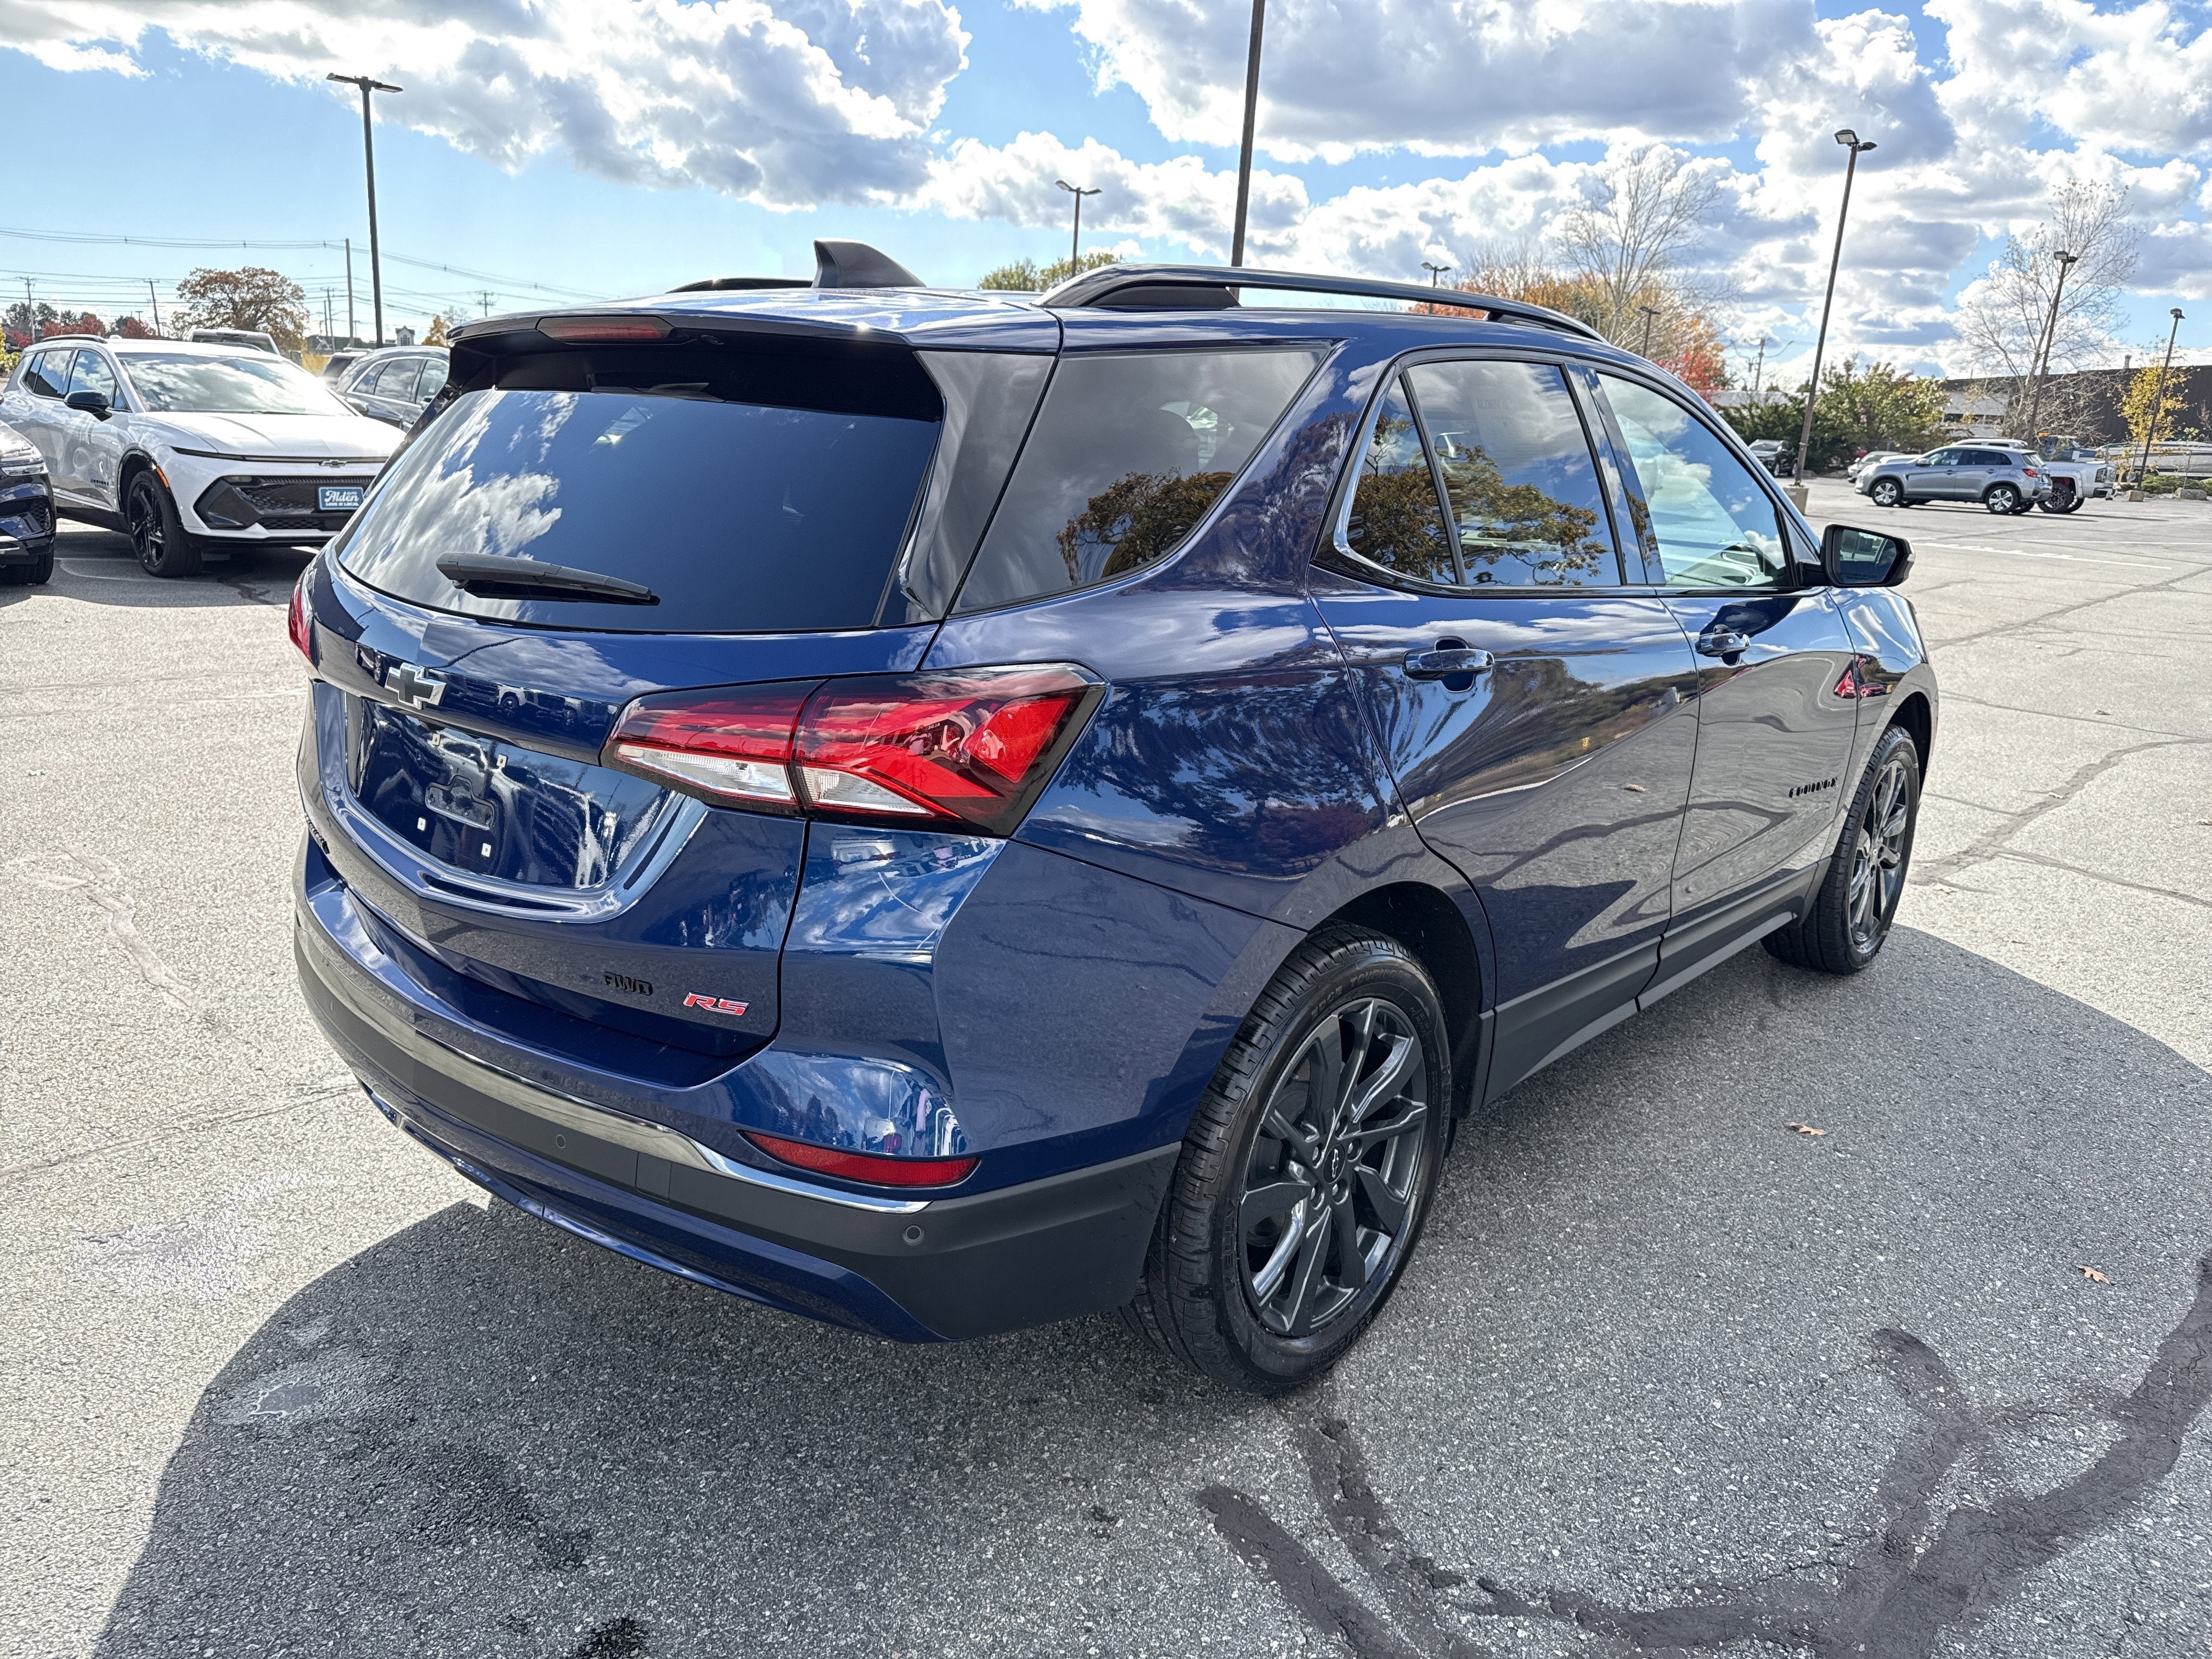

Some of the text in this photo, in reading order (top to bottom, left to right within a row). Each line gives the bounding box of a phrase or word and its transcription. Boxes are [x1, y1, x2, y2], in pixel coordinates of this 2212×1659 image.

[324, 490, 359, 502] Alden
[683, 991, 751, 1015] RS
[1311, 985, 1344, 1018] EDGE
[1350, 968, 1397, 988] TOURING
[1440, 1064, 1451, 1141] KELLY
